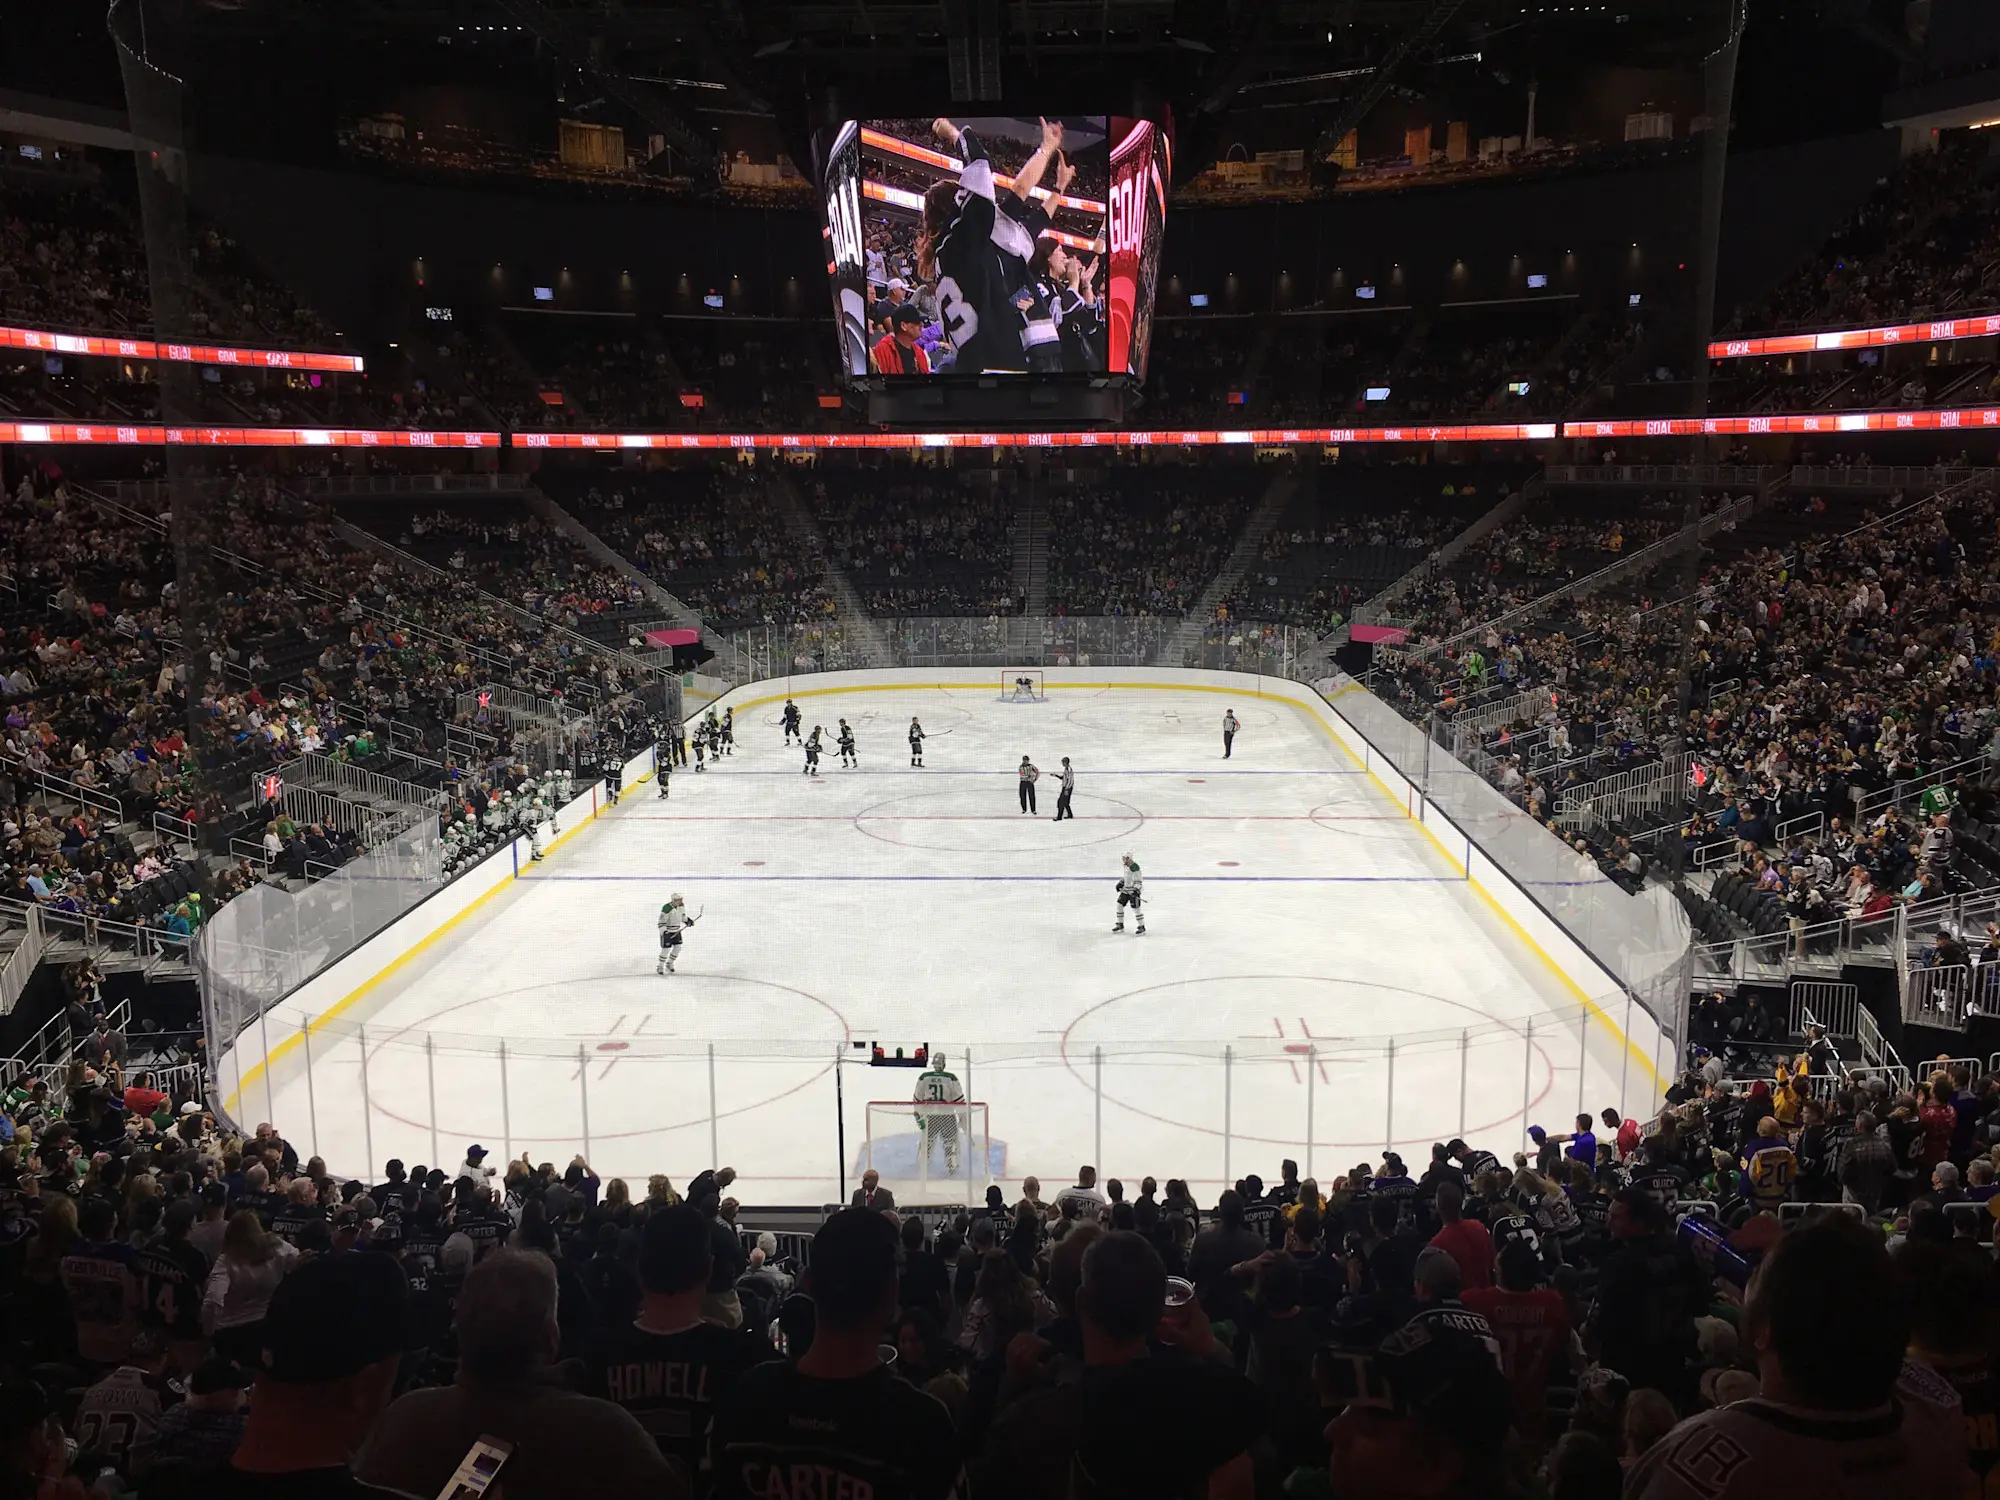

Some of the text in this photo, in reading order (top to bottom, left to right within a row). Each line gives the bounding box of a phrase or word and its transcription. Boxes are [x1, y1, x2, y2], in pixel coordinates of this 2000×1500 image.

[1931, 322, 1956, 340] GOAL
[119, 342, 139, 355] GOAL
[168, 345, 193, 361] GOAL
[218, 350, 238, 362] GOAL
[1748, 418, 1772, 433] GOAL
[1940, 411, 1962, 428] GOAL
[117, 428, 140, 443] GOAL
[1330, 429, 1356, 441] GOAL
[1647, 421, 1673, 435] GOAL
[409, 432, 436, 446] GOAL
[526, 433, 551, 446] GOAL
[1028, 434, 1054, 446] GOAL
[1130, 432, 1152, 444] GOAL
[928, 1084, 943, 1101] 31
[1758, 1160, 1788, 1188] 20
[1652, 1178, 1676, 1188] QUICK
[461, 1225, 497, 1238] CARTER
[410, 1277, 429, 1292] 32
[1427, 1312, 1491, 1334] CARTER
[607, 1361, 712, 1403] HOWELL
[788, 1414, 839, 1433] Reebok
[741, 1461, 876, 1500] CARTER
